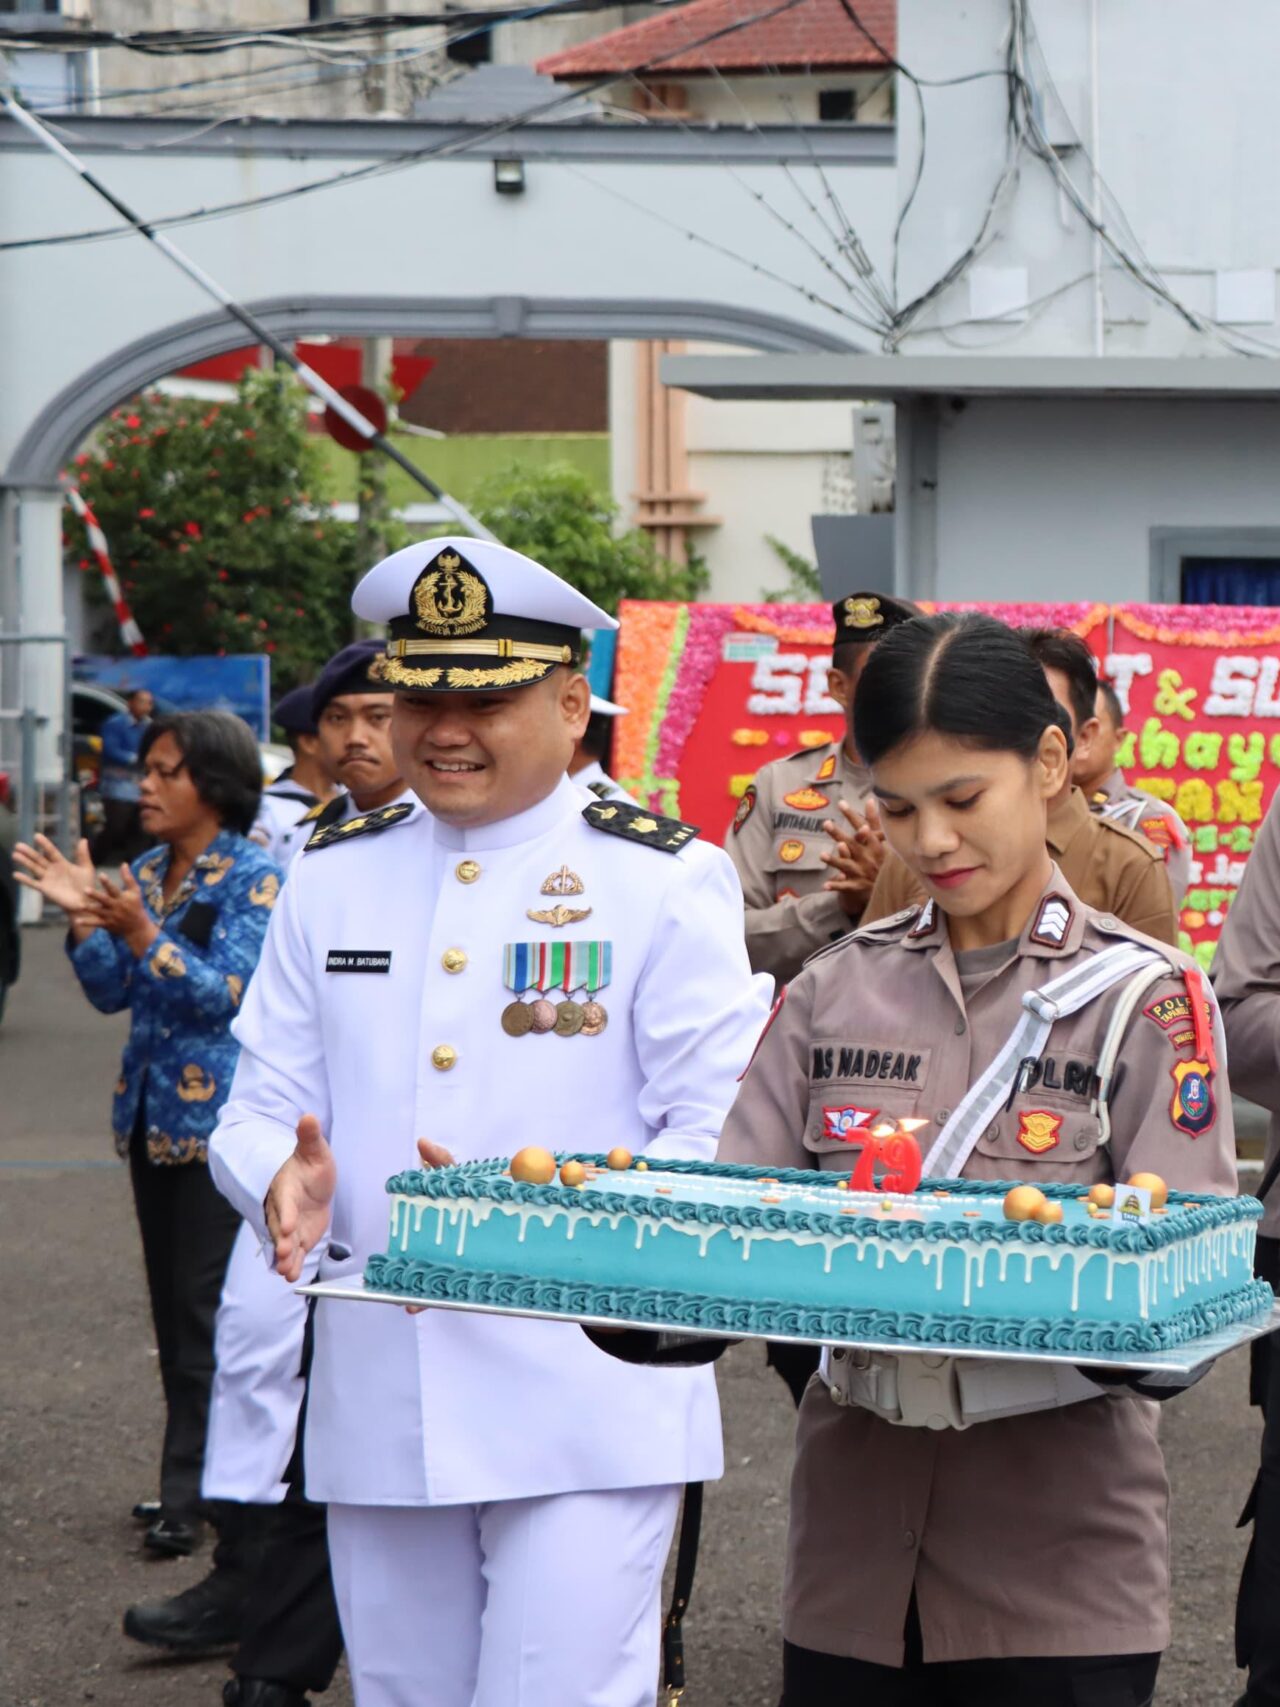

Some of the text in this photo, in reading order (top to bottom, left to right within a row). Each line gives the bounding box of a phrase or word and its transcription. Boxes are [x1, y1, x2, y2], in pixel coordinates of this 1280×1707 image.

[1154, 669, 1198, 720] &
[666, 826, 694, 846] TNI
[328, 956, 346, 966] INDRA
[357, 956, 390, 966] BATUBARA
[837, 1047, 921, 1081] NADEAK
[846, 1127, 922, 1195] 79
